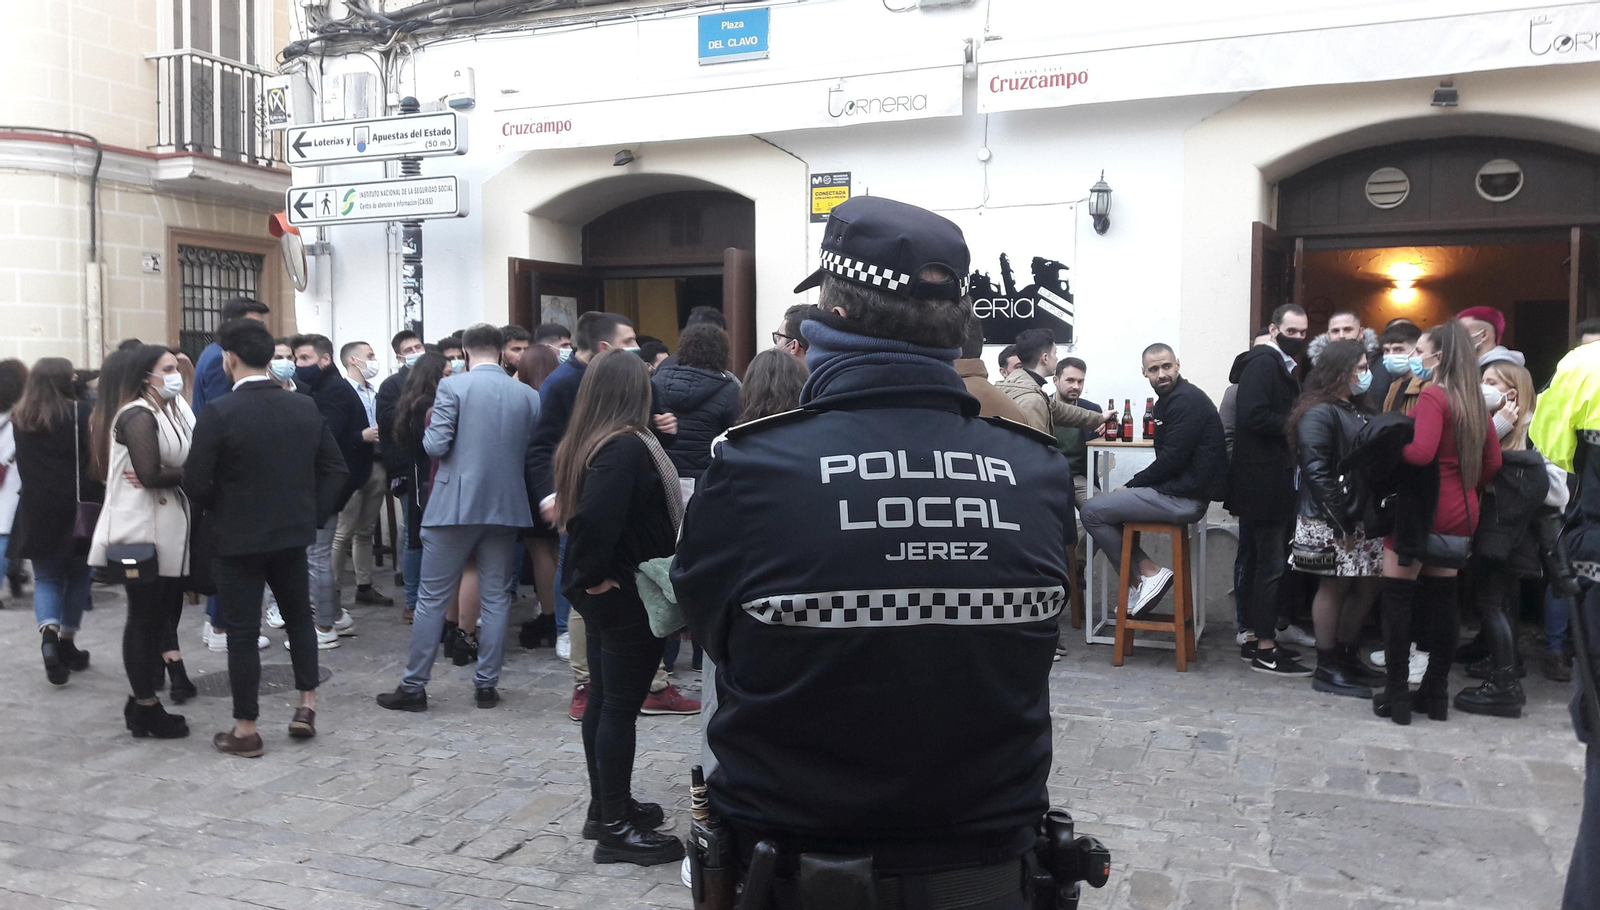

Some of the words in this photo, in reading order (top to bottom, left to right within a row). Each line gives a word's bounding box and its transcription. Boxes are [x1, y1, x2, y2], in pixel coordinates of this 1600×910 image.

[721, 21, 745, 30] Plaza
[708, 39, 725, 49] DEL
[727, 35, 759, 47] CLAVO
[989, 70, 1089, 93] Cruzcampo
[502, 119, 572, 136] Cruzcampo
[314, 136, 345, 147] Loterías
[346, 137, 351, 147] y
[372, 132, 408, 142] Apuestas
[410, 129, 423, 138] del
[424, 127, 452, 137] Estado
[424, 141, 438, 150] (50
[440, 139, 452, 148] m.)
[359, 190, 380, 198] INSTITUTO
[380, 188, 401, 196] NACIONAL
[408, 187, 414, 195] LA
[414, 185, 438, 194] SEGURIDAD
[438, 184, 454, 193] SOCIAL
[360, 202, 372, 210] Centro
[373, 201, 377, 209] de
[819, 449, 1017, 486] POLICIA
[838, 496, 1021, 532] LOCAL
[885, 541, 989, 561] JEREZ
